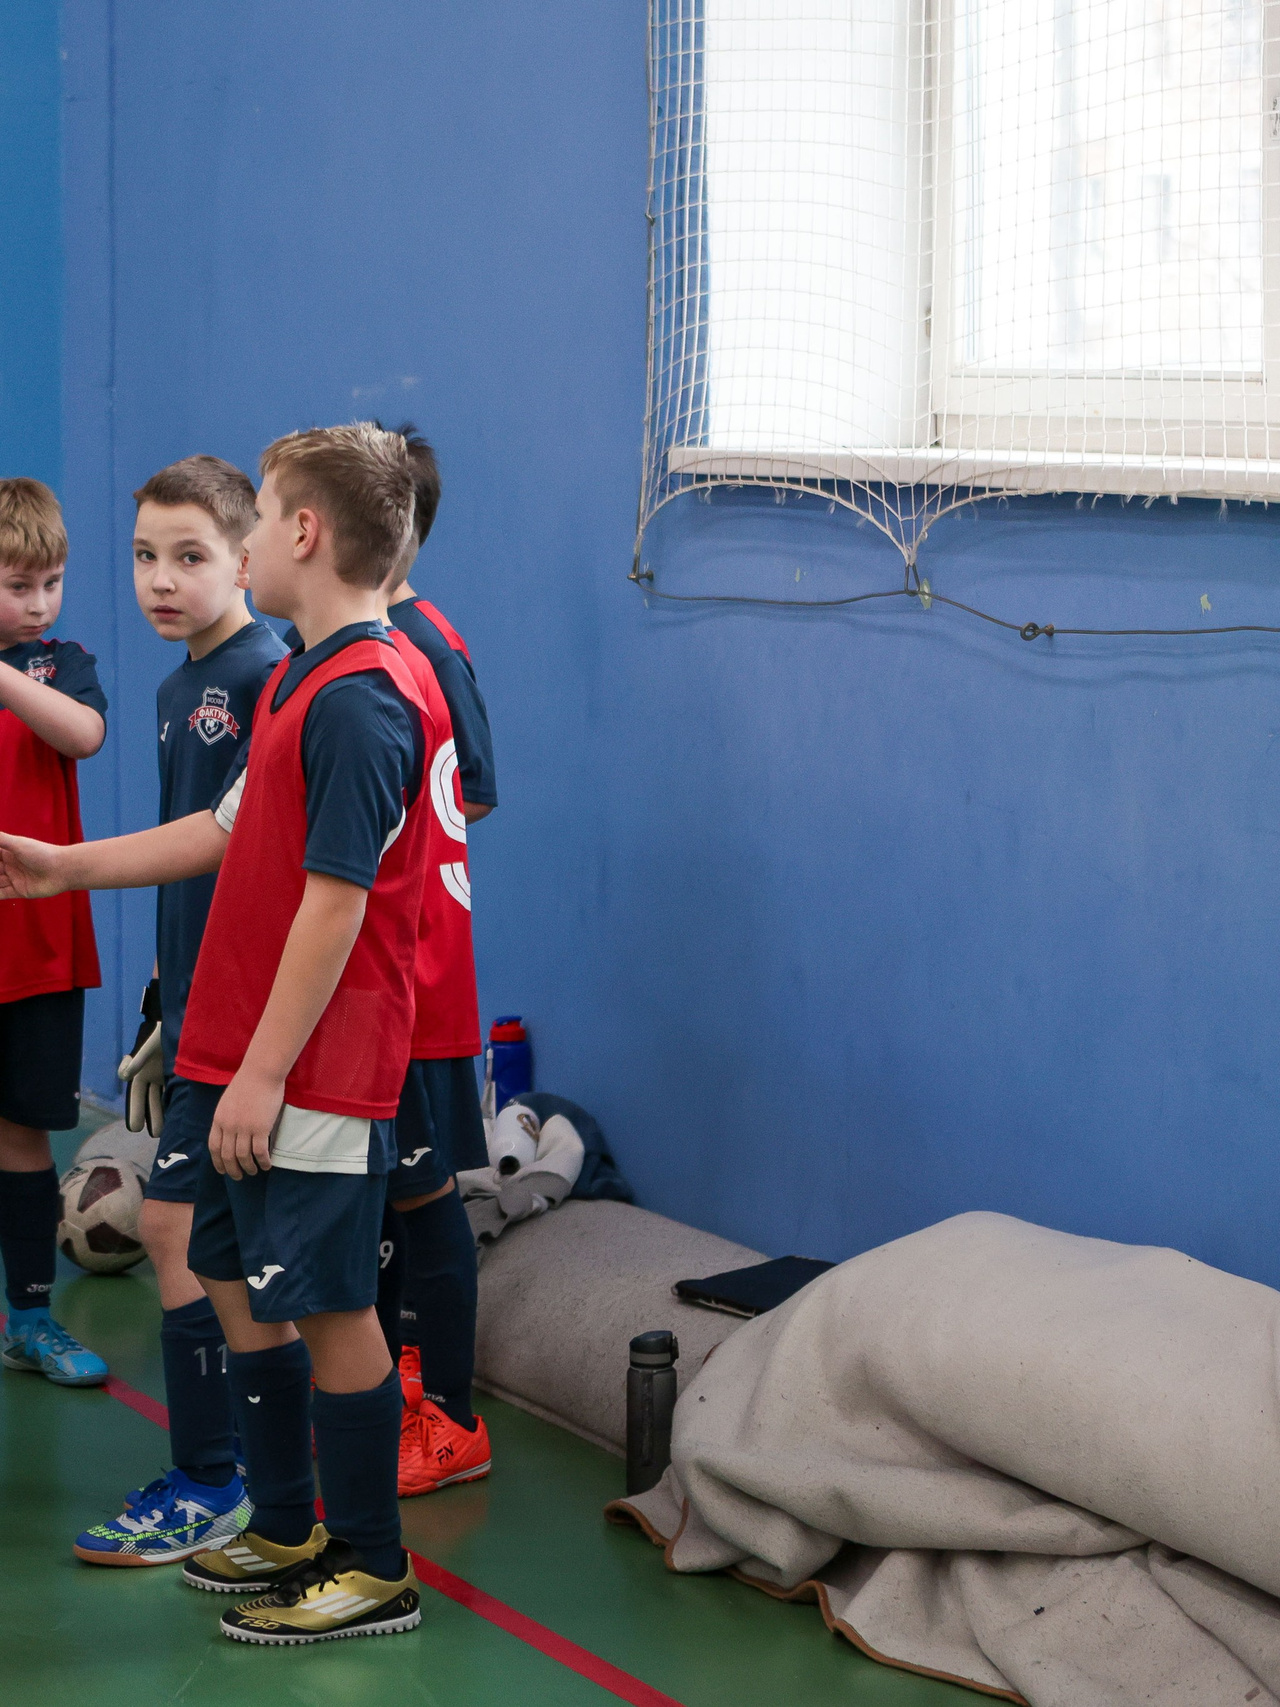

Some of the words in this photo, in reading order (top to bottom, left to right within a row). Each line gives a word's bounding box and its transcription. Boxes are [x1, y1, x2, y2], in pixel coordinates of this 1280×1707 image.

[199, 708, 229, 723] ФАКТУМ
[379, 1240, 394, 1269] 9
[194, 1343, 227, 1376] 11
